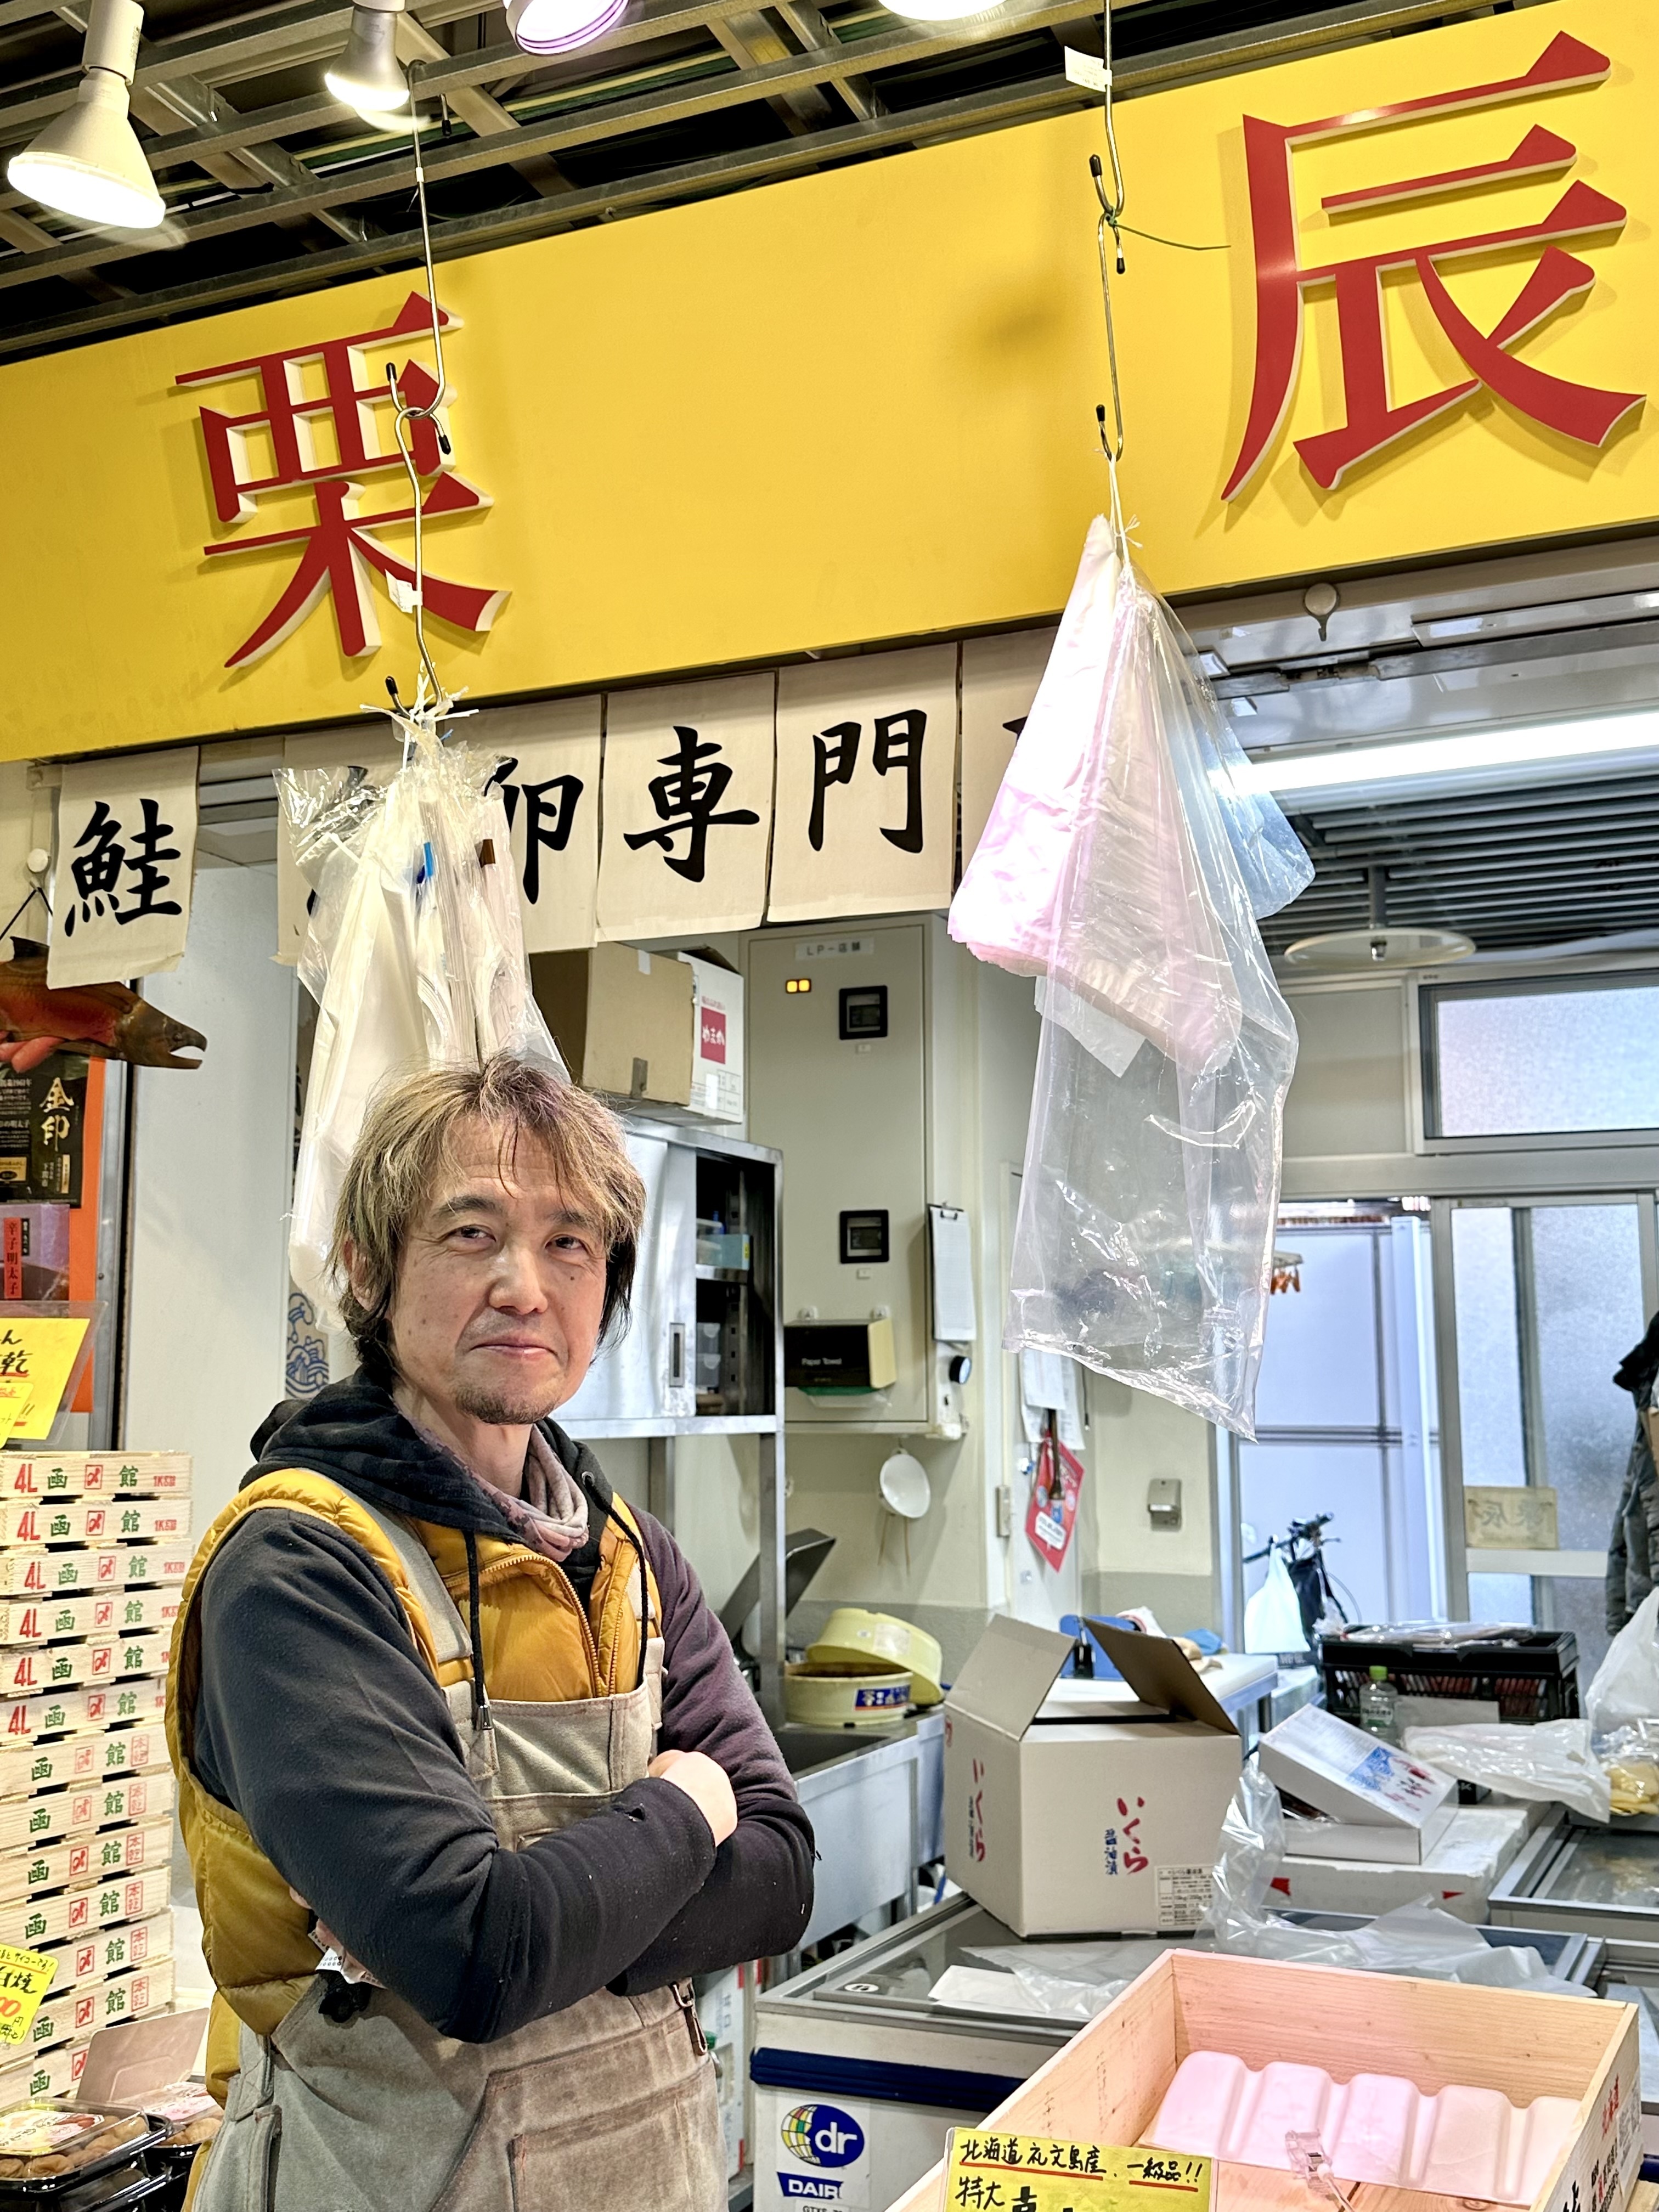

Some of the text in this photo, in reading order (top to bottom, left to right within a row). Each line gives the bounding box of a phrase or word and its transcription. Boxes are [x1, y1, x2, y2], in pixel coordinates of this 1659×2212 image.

[1221, 30, 1646, 502] 辰
[14, 1464, 37, 1493] 4L
[16, 1511, 41, 1541] 4L
[24, 1561, 46, 1589] 4L
[19, 1609, 42, 1638] 4L
[14, 1657, 38, 1686] 4L
[8, 1705, 31, 1735] 4L
[1116, 1796, 1149, 1875] いくら
[814, 2121, 857, 2154] dr
[788, 2179, 843, 2199] DAIR
